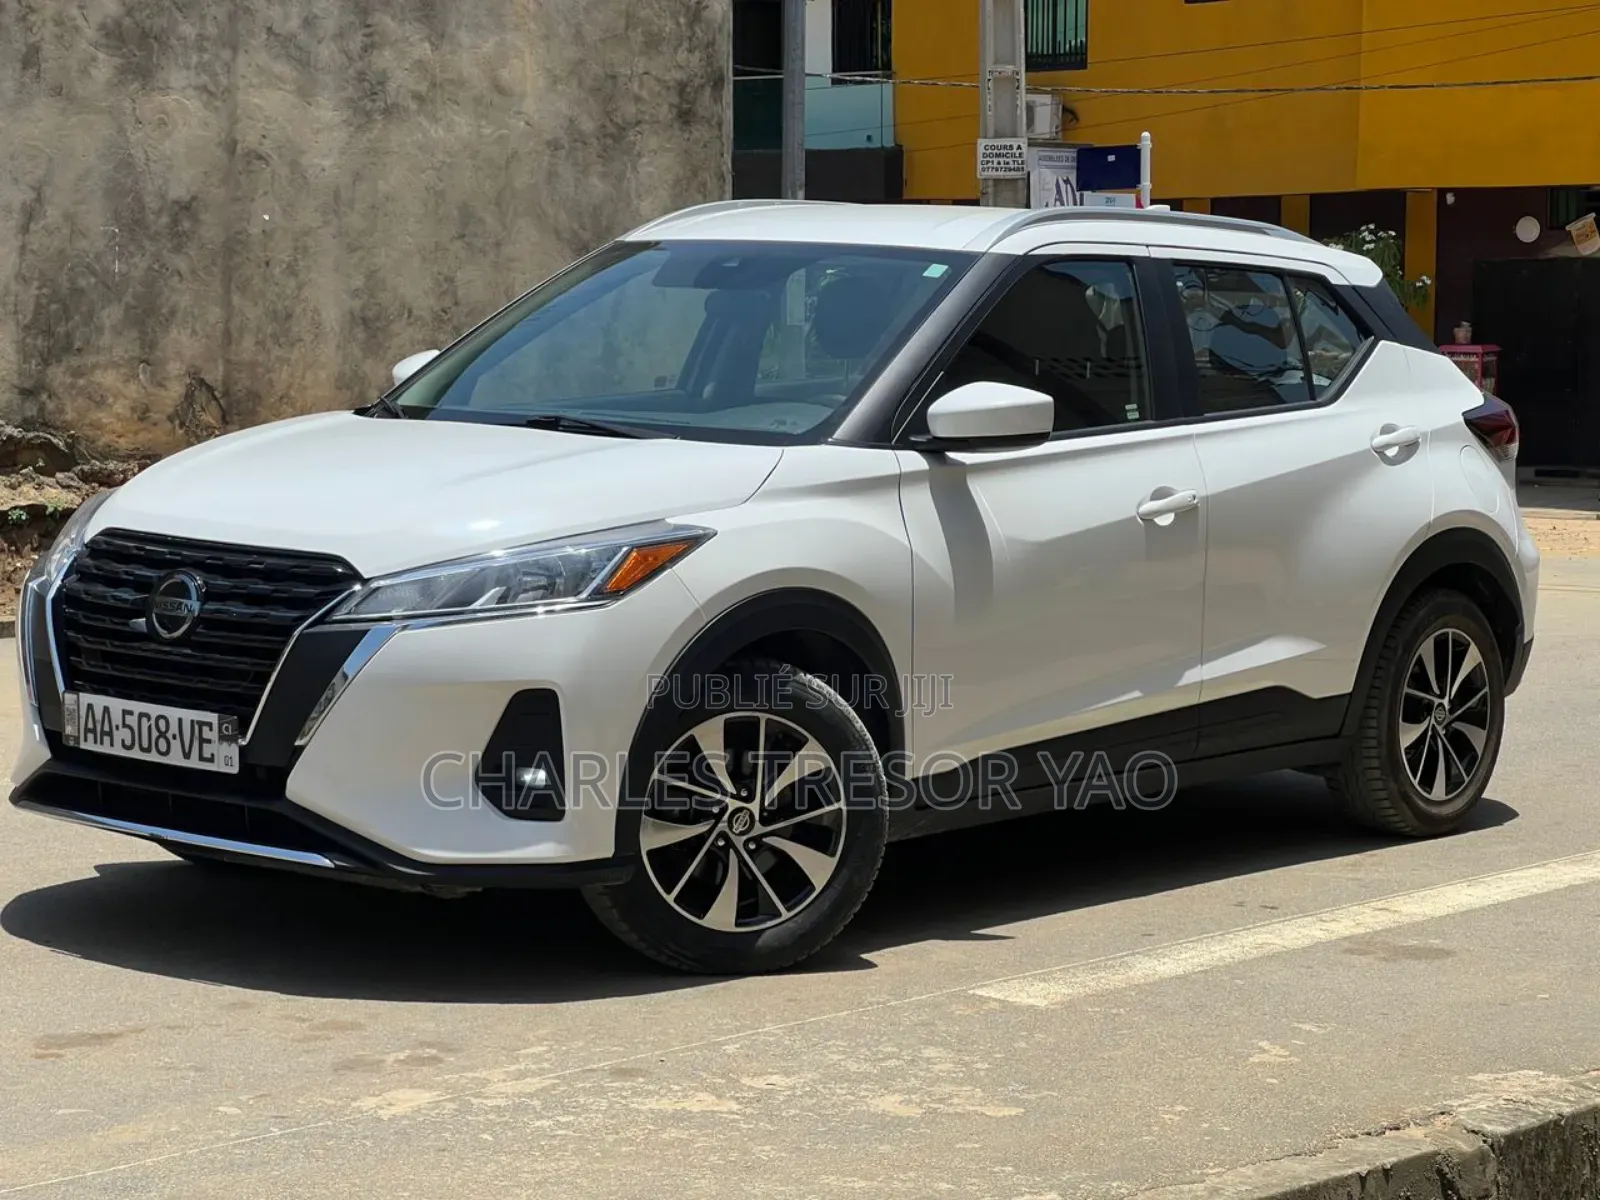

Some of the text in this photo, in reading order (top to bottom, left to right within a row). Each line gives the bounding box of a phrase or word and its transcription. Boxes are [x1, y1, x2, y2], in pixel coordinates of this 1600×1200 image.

[984, 143, 1023, 151] COURS A
[154, 600, 195, 613] NISSAN
